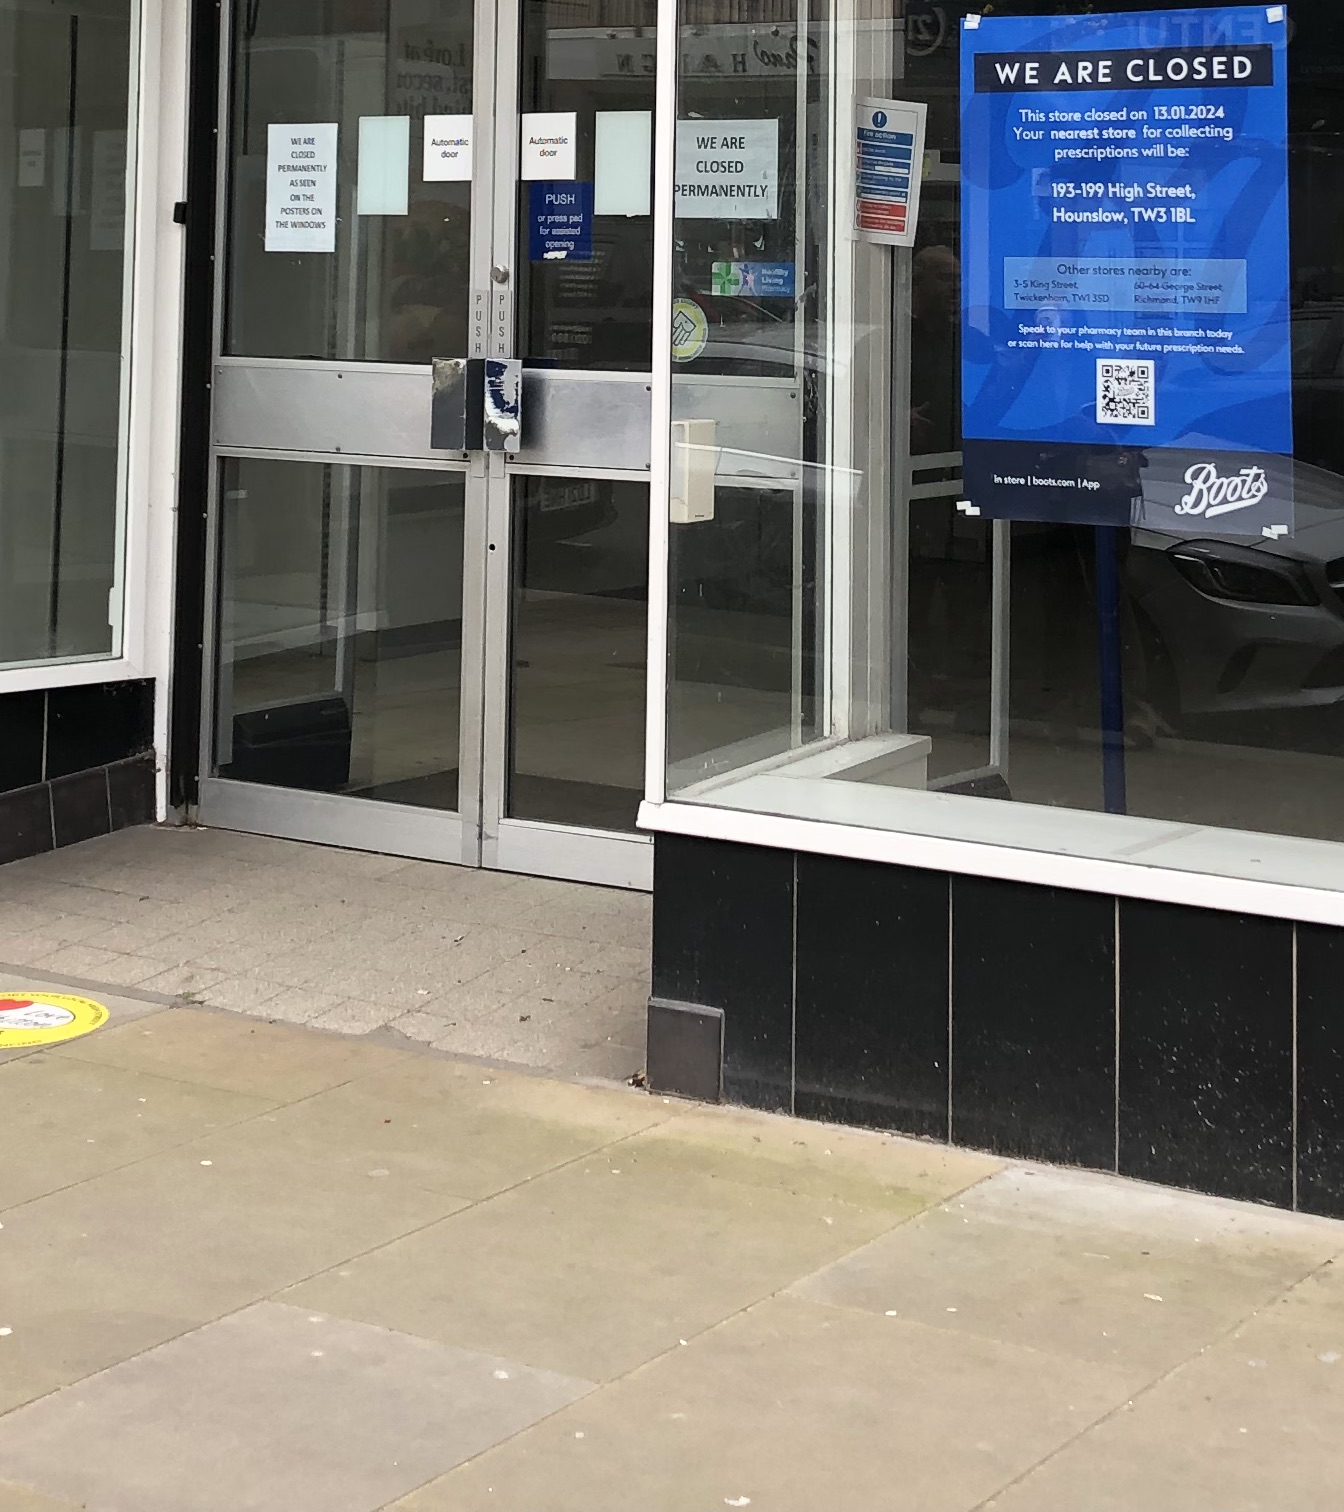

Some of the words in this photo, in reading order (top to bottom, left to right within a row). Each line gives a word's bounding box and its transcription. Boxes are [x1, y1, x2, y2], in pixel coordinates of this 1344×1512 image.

[994, 61, 1040, 85] WE
[1053, 59, 1113, 84] ARE
[1126, 55, 1253, 82] CLOSED
[1018, 108, 1046, 123] This
[1048, 109, 1082, 122] store
[1083, 107, 1127, 121] closed
[1129, 109, 1148, 121] on
[1153, 105, 1225, 121] 13.01.2024
[1013, 127, 1044, 140] Your
[1050, 128, 1100, 140] nearest
[1101, 127, 1136, 139] store
[1143, 125, 1163, 139] for
[1165, 125, 1234, 142] collecting
[290, 137, 302, 146] WE
[302, 137, 316, 146] ARE
[430, 138, 469, 147] Automatic
[529, 136, 569, 146] Automatic
[696, 136, 718, 150] WE
[720, 136, 746, 150] ARE
[290, 150, 316, 159] CLOSED
[441, 150, 459, 159] door
[539, 148, 558, 157] door
[1054, 145, 1139, 162] prescriptions
[1141, 144, 1165, 158] will
[1167, 144, 1190, 158] be:
[277, 164, 328, 173] PERMANENTLY
[695, 160, 745, 174] CLOSED
[289, 178, 299, 187] AS
[299, 178, 317, 187] SEEN
[674, 183, 769, 198] PERMANENTLY
[1051, 182, 1105, 198] 193-199
[1107, 181, 1144, 202] High
[1146, 181, 1197, 200] Street,
[289, 193, 301, 202] ON
[302, 193, 315, 202] THE
[545, 193, 576, 205] PUSH
[280, 207, 310, 216] POSTERS
[310, 207, 323, 216] ON
[1052, 207, 1129, 225] Hounslow,
[1130, 207, 1168, 224] TW3
[1170, 207, 1196, 224] 1BL
[275, 220, 289, 229] THE
[290, 220, 326, 229] WINDOWS
[569, 213, 584, 225] pad
[539, 225, 550, 236] for
[545, 239, 575, 251] opening
[1056, 263, 1090, 276] Other
[1092, 265, 1126, 277] stores
[1128, 264, 1168, 279] nearby
[1169, 267, 1192, 277] are:
[1029, 279, 1050, 292] King
[474, 294, 482, 354] PUSH
[498, 294, 506, 354] PUSH
[1018, 324, 1045, 336] Speak
[1046, 325, 1056, 335] to
[1056, 327, 1077, 338] your
[1078, 326, 1122, 338] pharmacy
[1123, 327, 1147, 336] team
[1147, 326, 1156, 336] in
[1156, 326, 1173, 337] this
[1173, 327, 1205, 338] branch
[1206, 328, 1233, 340] today
[1018, 340, 1039, 348] scan
[1039, 339, 1059, 349] here
[1060, 339, 1074, 349] for
[1074, 339, 1094, 351] help
[1094, 339, 1114, 350] with
[1115, 342, 1135, 352] your
[1135, 341, 1162, 351] future
[1163, 343, 1215, 355] prescription
[1216, 345, 1245, 355] needs.
[993, 474, 1002, 485] In
[1003, 475, 1026, 486] store
[1032, 476, 1076, 488] boots.com
[1081, 478, 1101, 491] App
[1174, 462, 1268, 519] Boots
